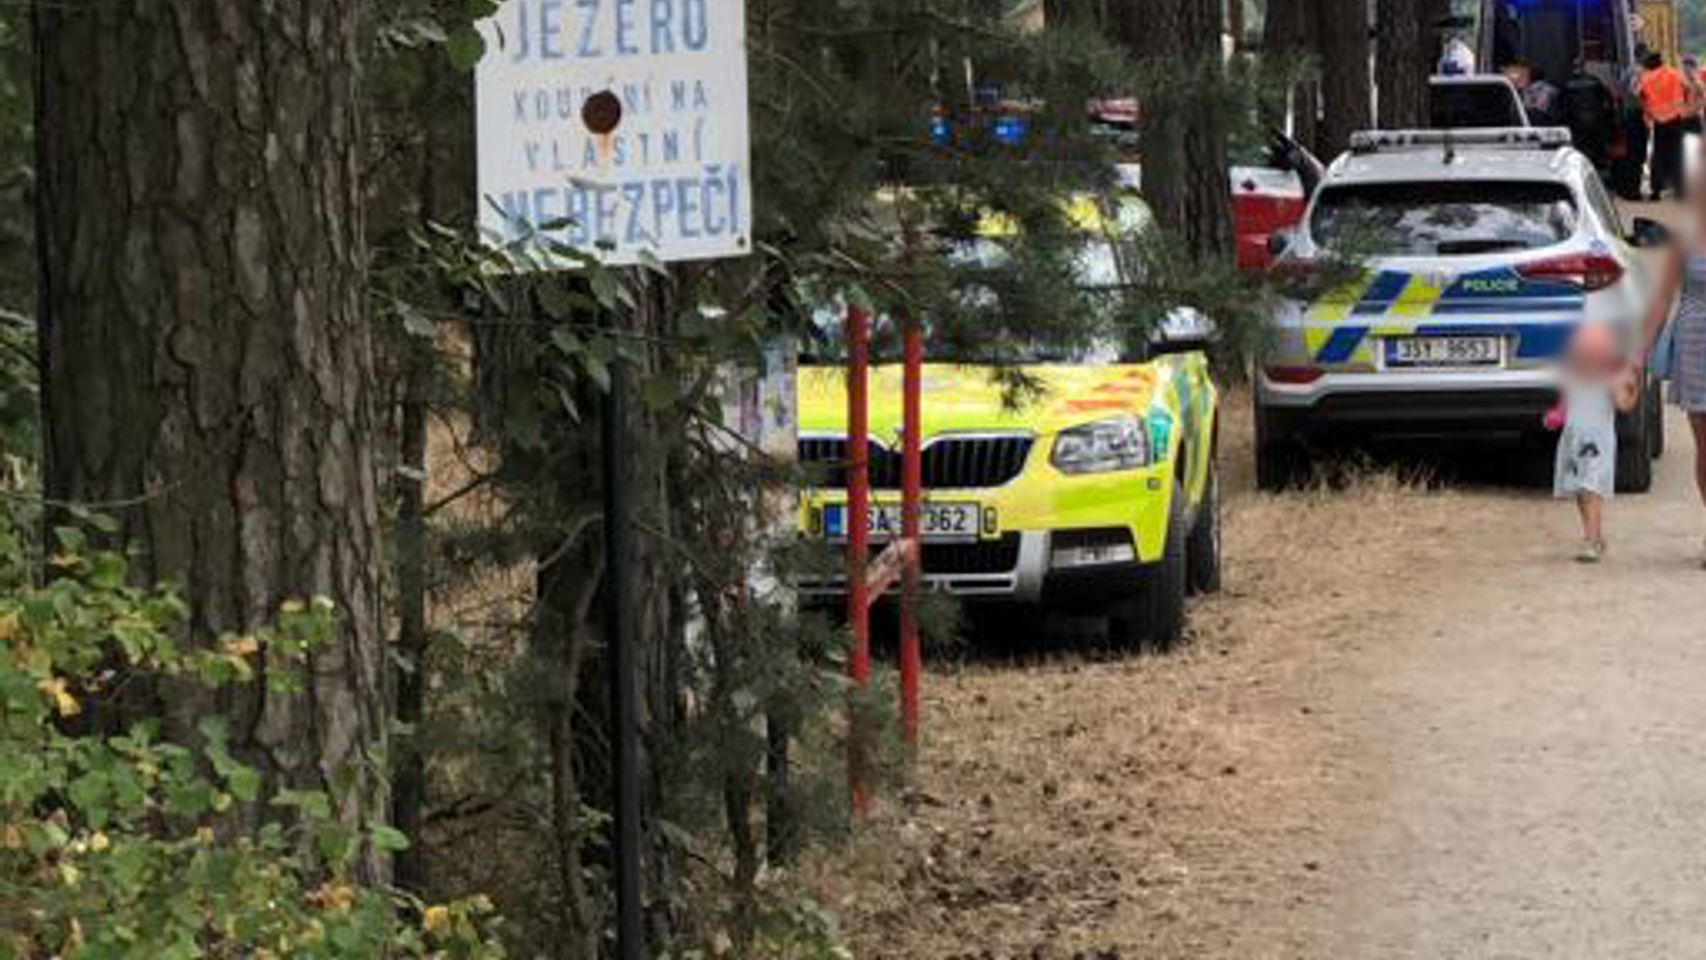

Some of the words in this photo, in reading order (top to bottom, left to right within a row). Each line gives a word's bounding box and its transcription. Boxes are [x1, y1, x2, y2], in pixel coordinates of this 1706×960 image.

[513, 76, 654, 123] KOUNÍ
[670, 78, 708, 110] NA
[524, 116, 707, 172] VLASTNÍ
[1462, 279, 1519, 292] POLICIE
